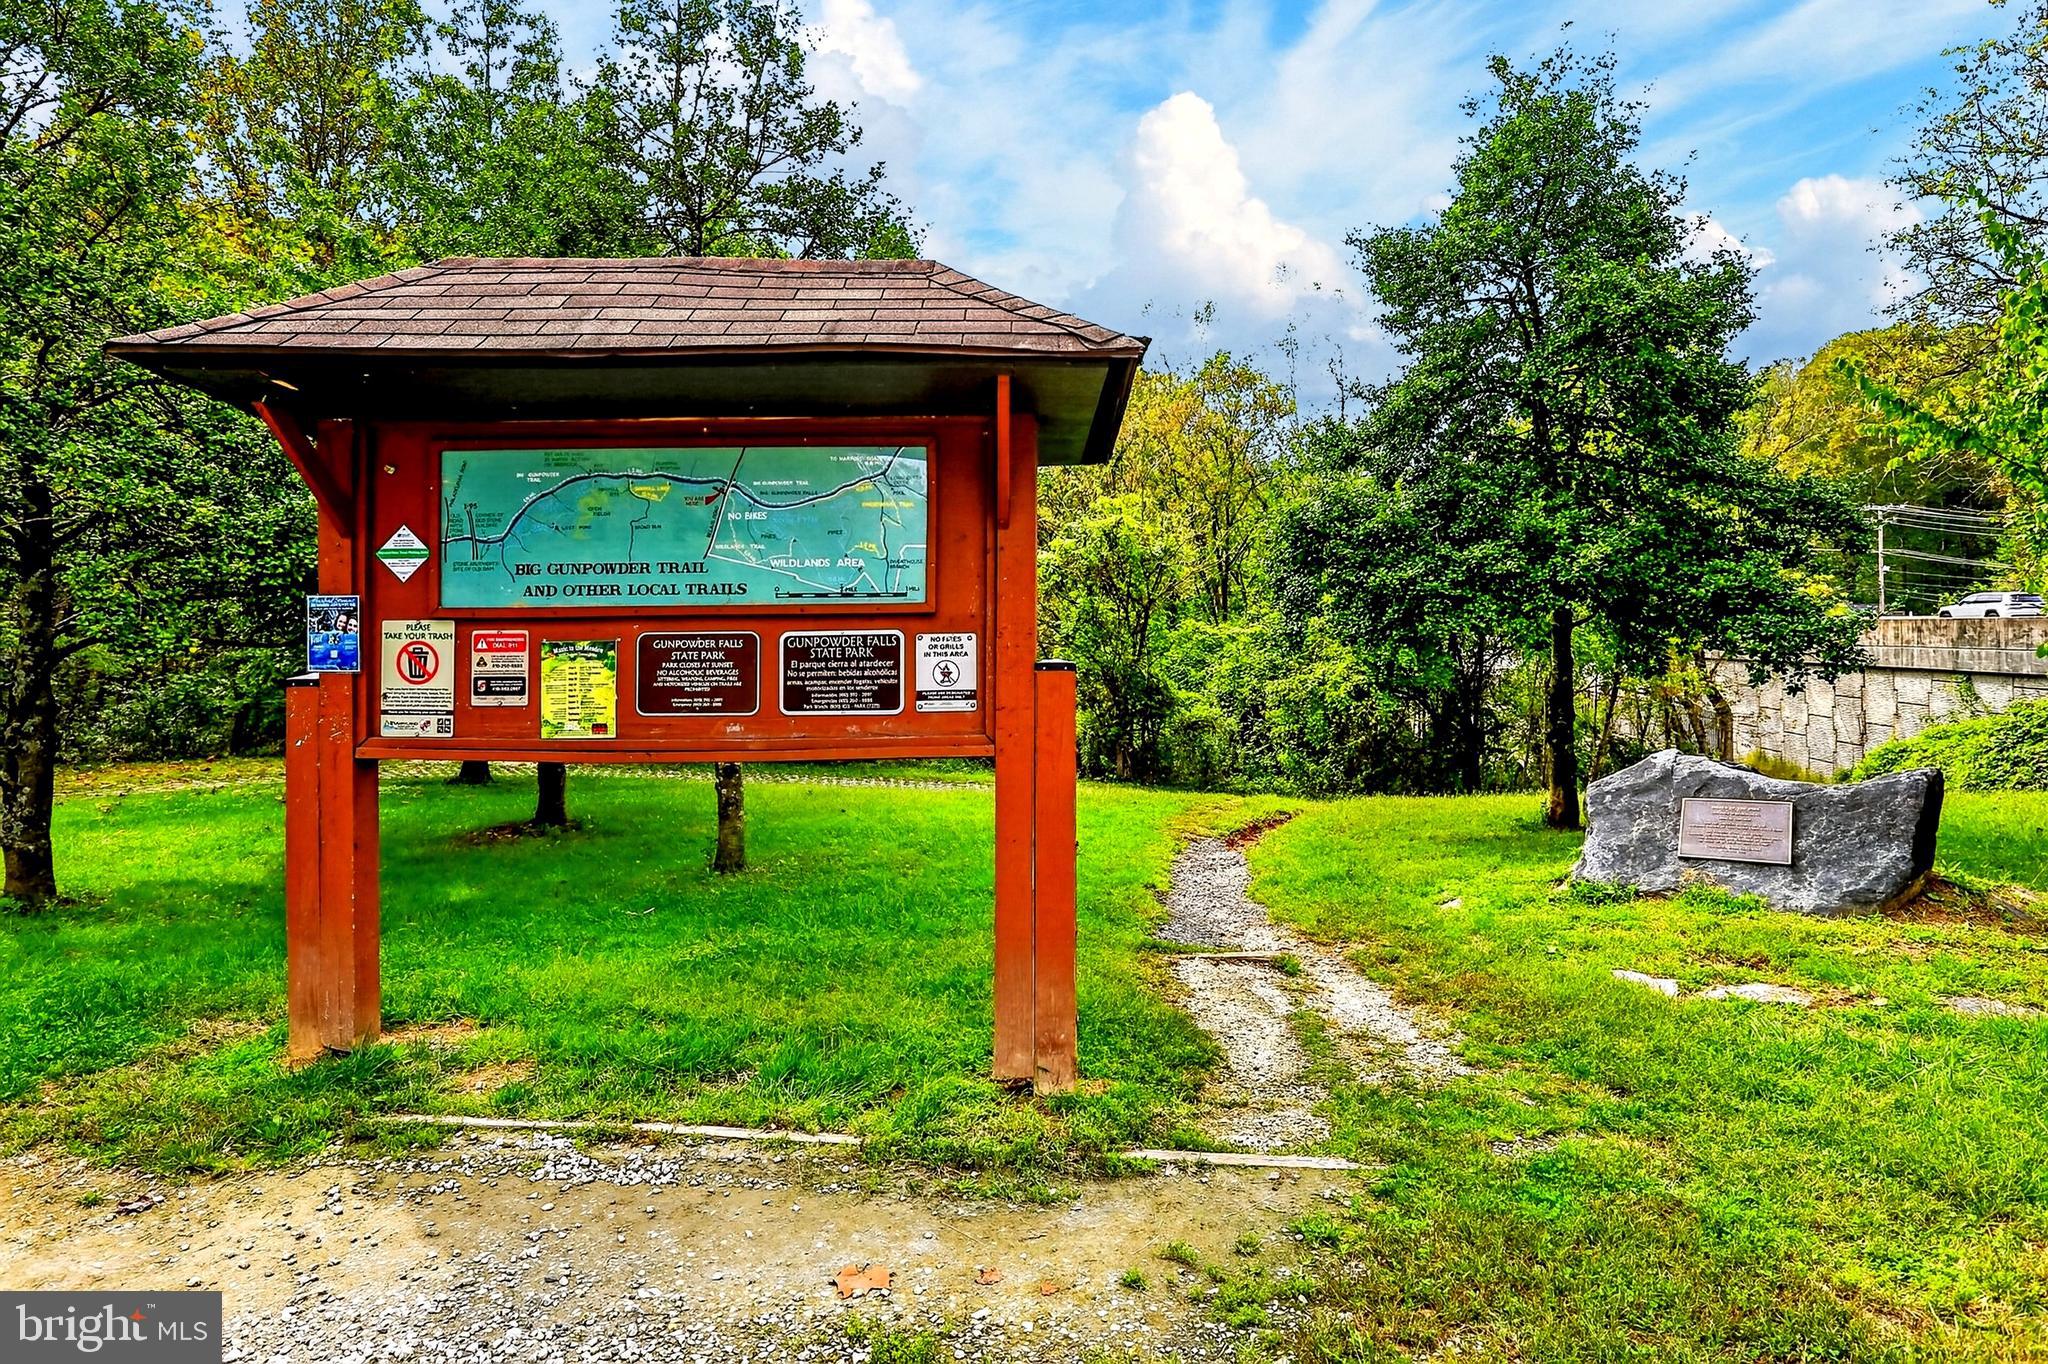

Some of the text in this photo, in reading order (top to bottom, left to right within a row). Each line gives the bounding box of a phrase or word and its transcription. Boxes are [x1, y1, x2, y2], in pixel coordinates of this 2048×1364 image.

[464, 502, 478, 510] I-95
[744, 512, 768, 520] BIKES
[770, 558, 866, 568] WILDLANDS AREA
[514, 562, 709, 576] BIG GUNPOWDER TRAIL
[522, 583, 748, 597] AND OTHER LOCAL TRAILS
[653, 639, 744, 648] GUNPOWDER FALLS
[787, 635, 897, 648] GUNPOWDER FALLS
[671, 651, 725, 660] STATE PARK
[810, 647, 874, 658] STATE PARK
[791, 660, 798, 668] El
[800, 662, 826, 670] parque
[828, 660, 848, 668] cierra
